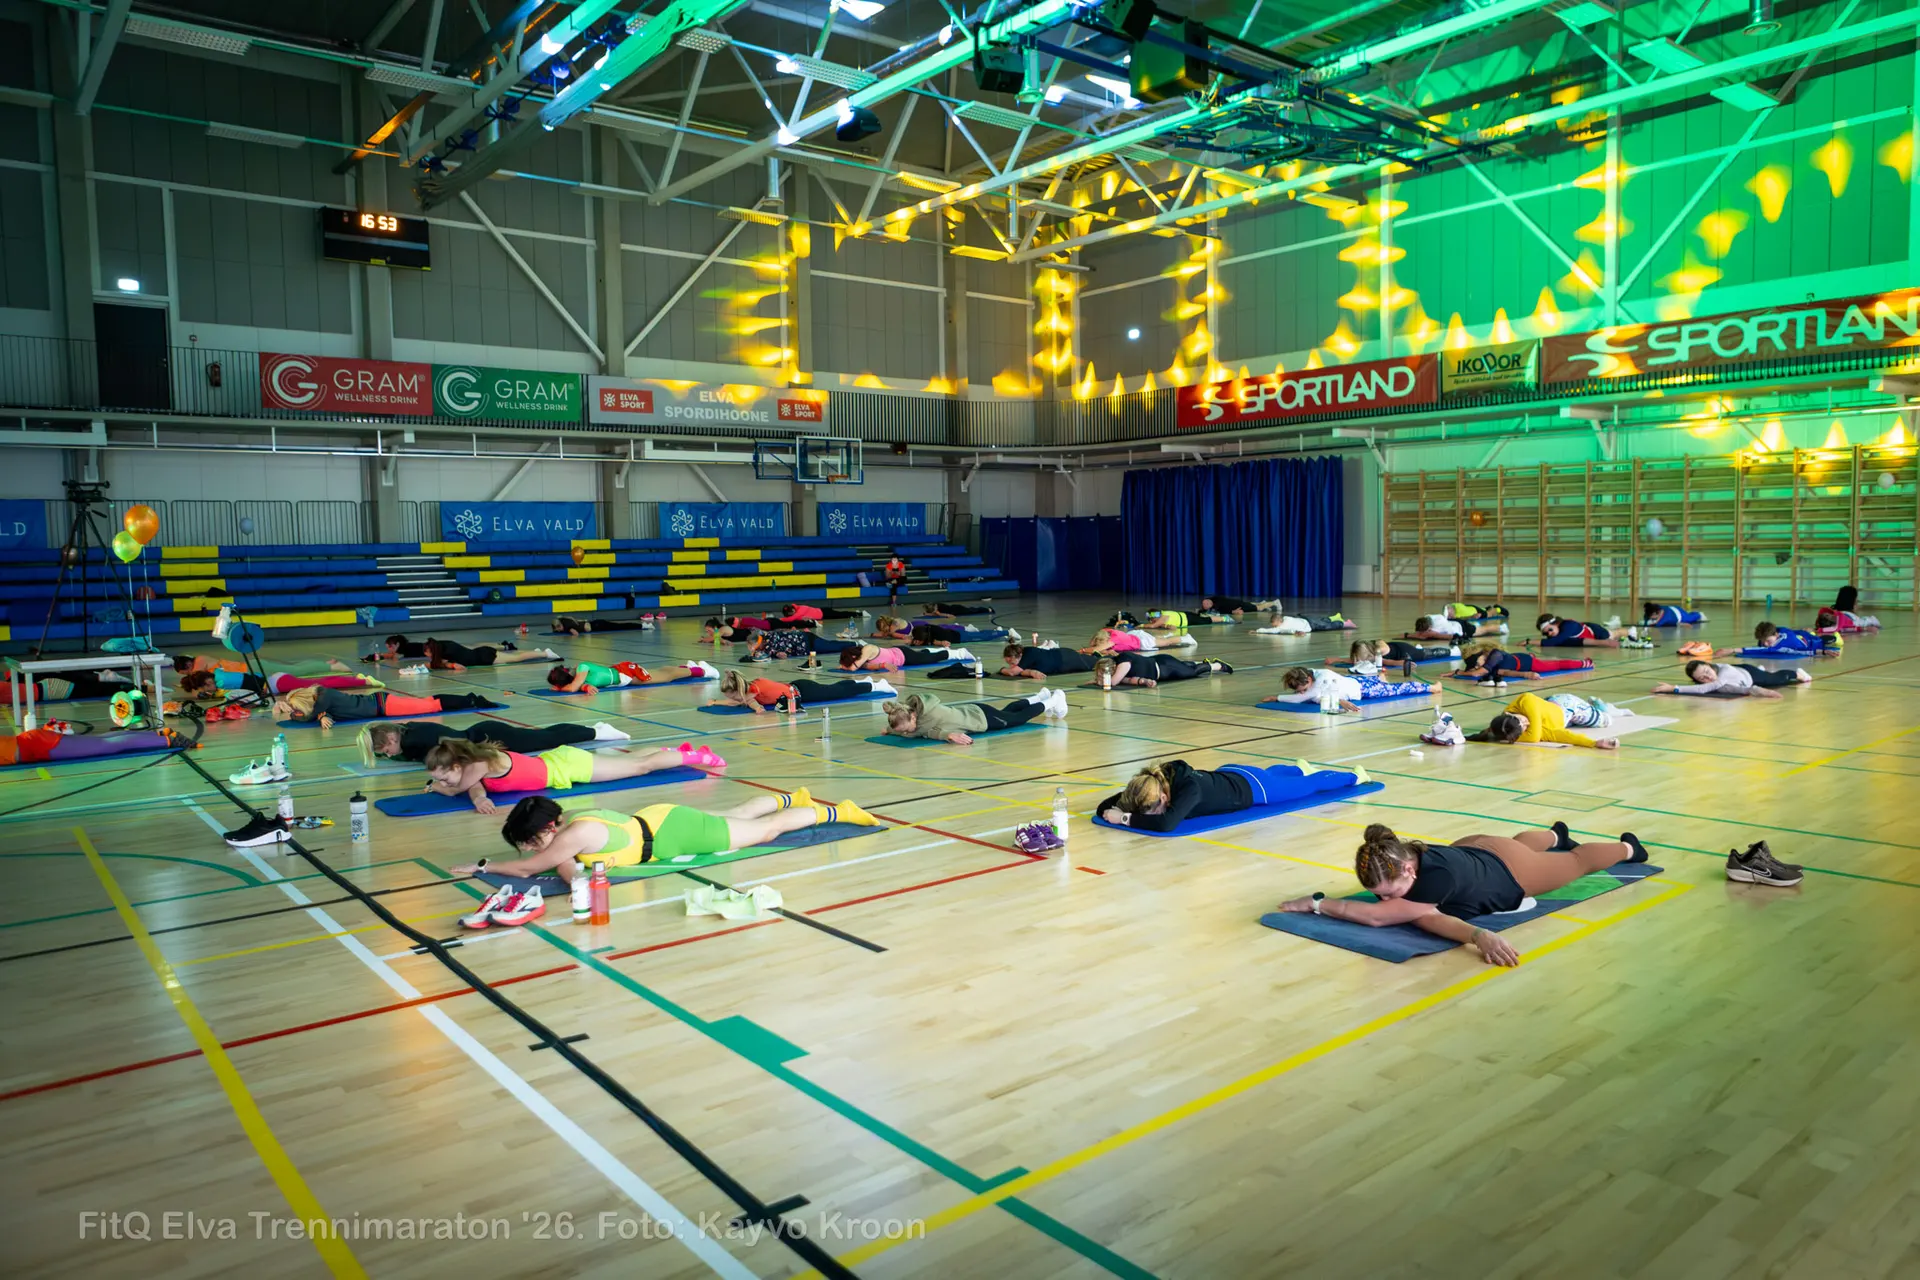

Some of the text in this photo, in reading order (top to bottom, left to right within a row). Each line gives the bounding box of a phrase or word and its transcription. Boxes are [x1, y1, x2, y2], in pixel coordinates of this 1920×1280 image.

[361, 213, 398, 231] 16 53
[1647, 296, 1920, 366] SPORTLAN
[1457, 352, 1521, 374] IKODOR
[619, 393, 639, 401] ELVA
[699, 390, 736, 404] ELVA
[1240, 366, 1416, 414] SPORTLAND
[334, 392, 419, 404] WELLNESS DRINK
[620, 401, 646, 409] SPORT
[496, 401, 569, 411] WELLNESS DRINK
[794, 403, 811, 411] ELVA
[664, 405, 770, 422] SPORDIHOONE
[794, 410, 816, 418] SPORT
[493, 516, 585, 531] ELVA VALD
[700, 515, 774, 529] ELVA VALD
[853, 515, 919, 528] ELVA VALD
